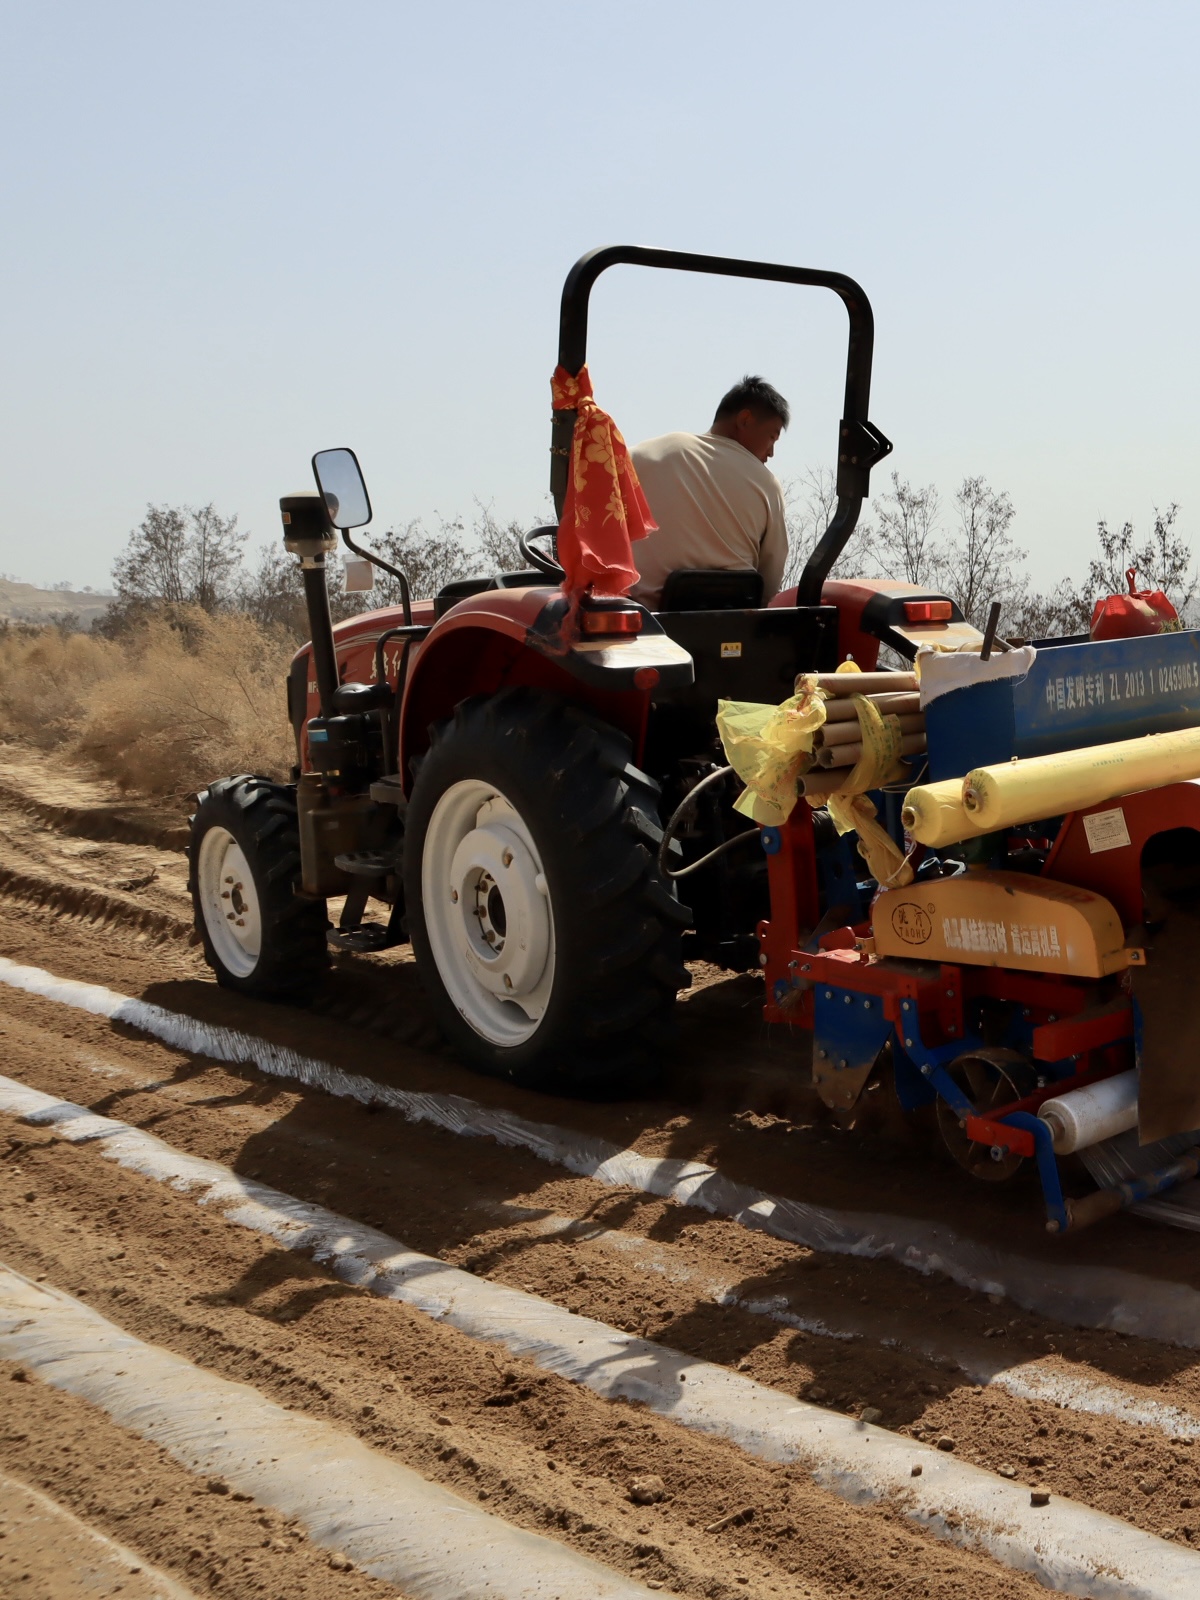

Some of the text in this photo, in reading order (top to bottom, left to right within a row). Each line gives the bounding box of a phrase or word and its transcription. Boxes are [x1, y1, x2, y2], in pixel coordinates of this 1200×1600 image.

[1045, 673, 1105, 711] 中国发明专利
[1109, 673, 1121, 701] ZL
[1125, 670, 1145, 699] 2013
[1149, 669, 1154, 695] 1
[898, 926, 927, 940] TAOHE
